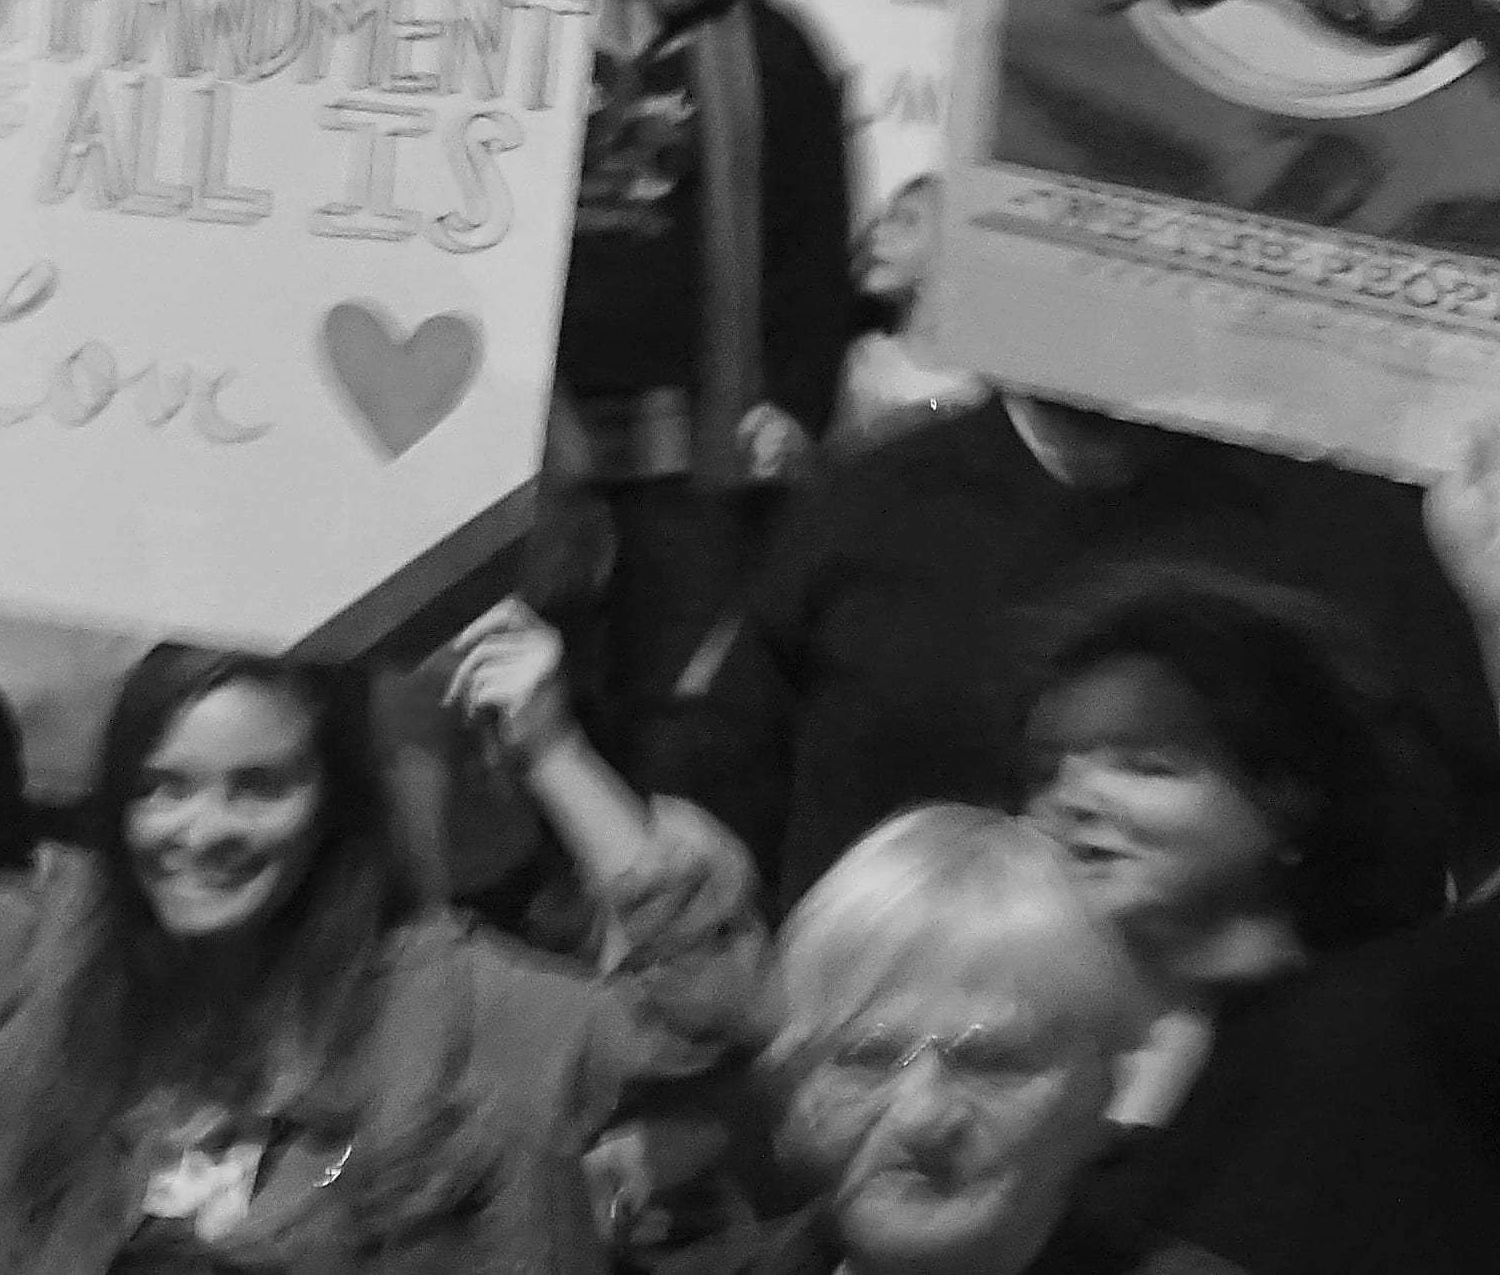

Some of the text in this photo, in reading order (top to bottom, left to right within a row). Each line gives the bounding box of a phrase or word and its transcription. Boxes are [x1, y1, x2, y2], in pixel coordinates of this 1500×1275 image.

[33, 65, 274, 230] ALL
[304, 98, 530, 255] IS
[1308, 247, 1500, 325] PEOP
